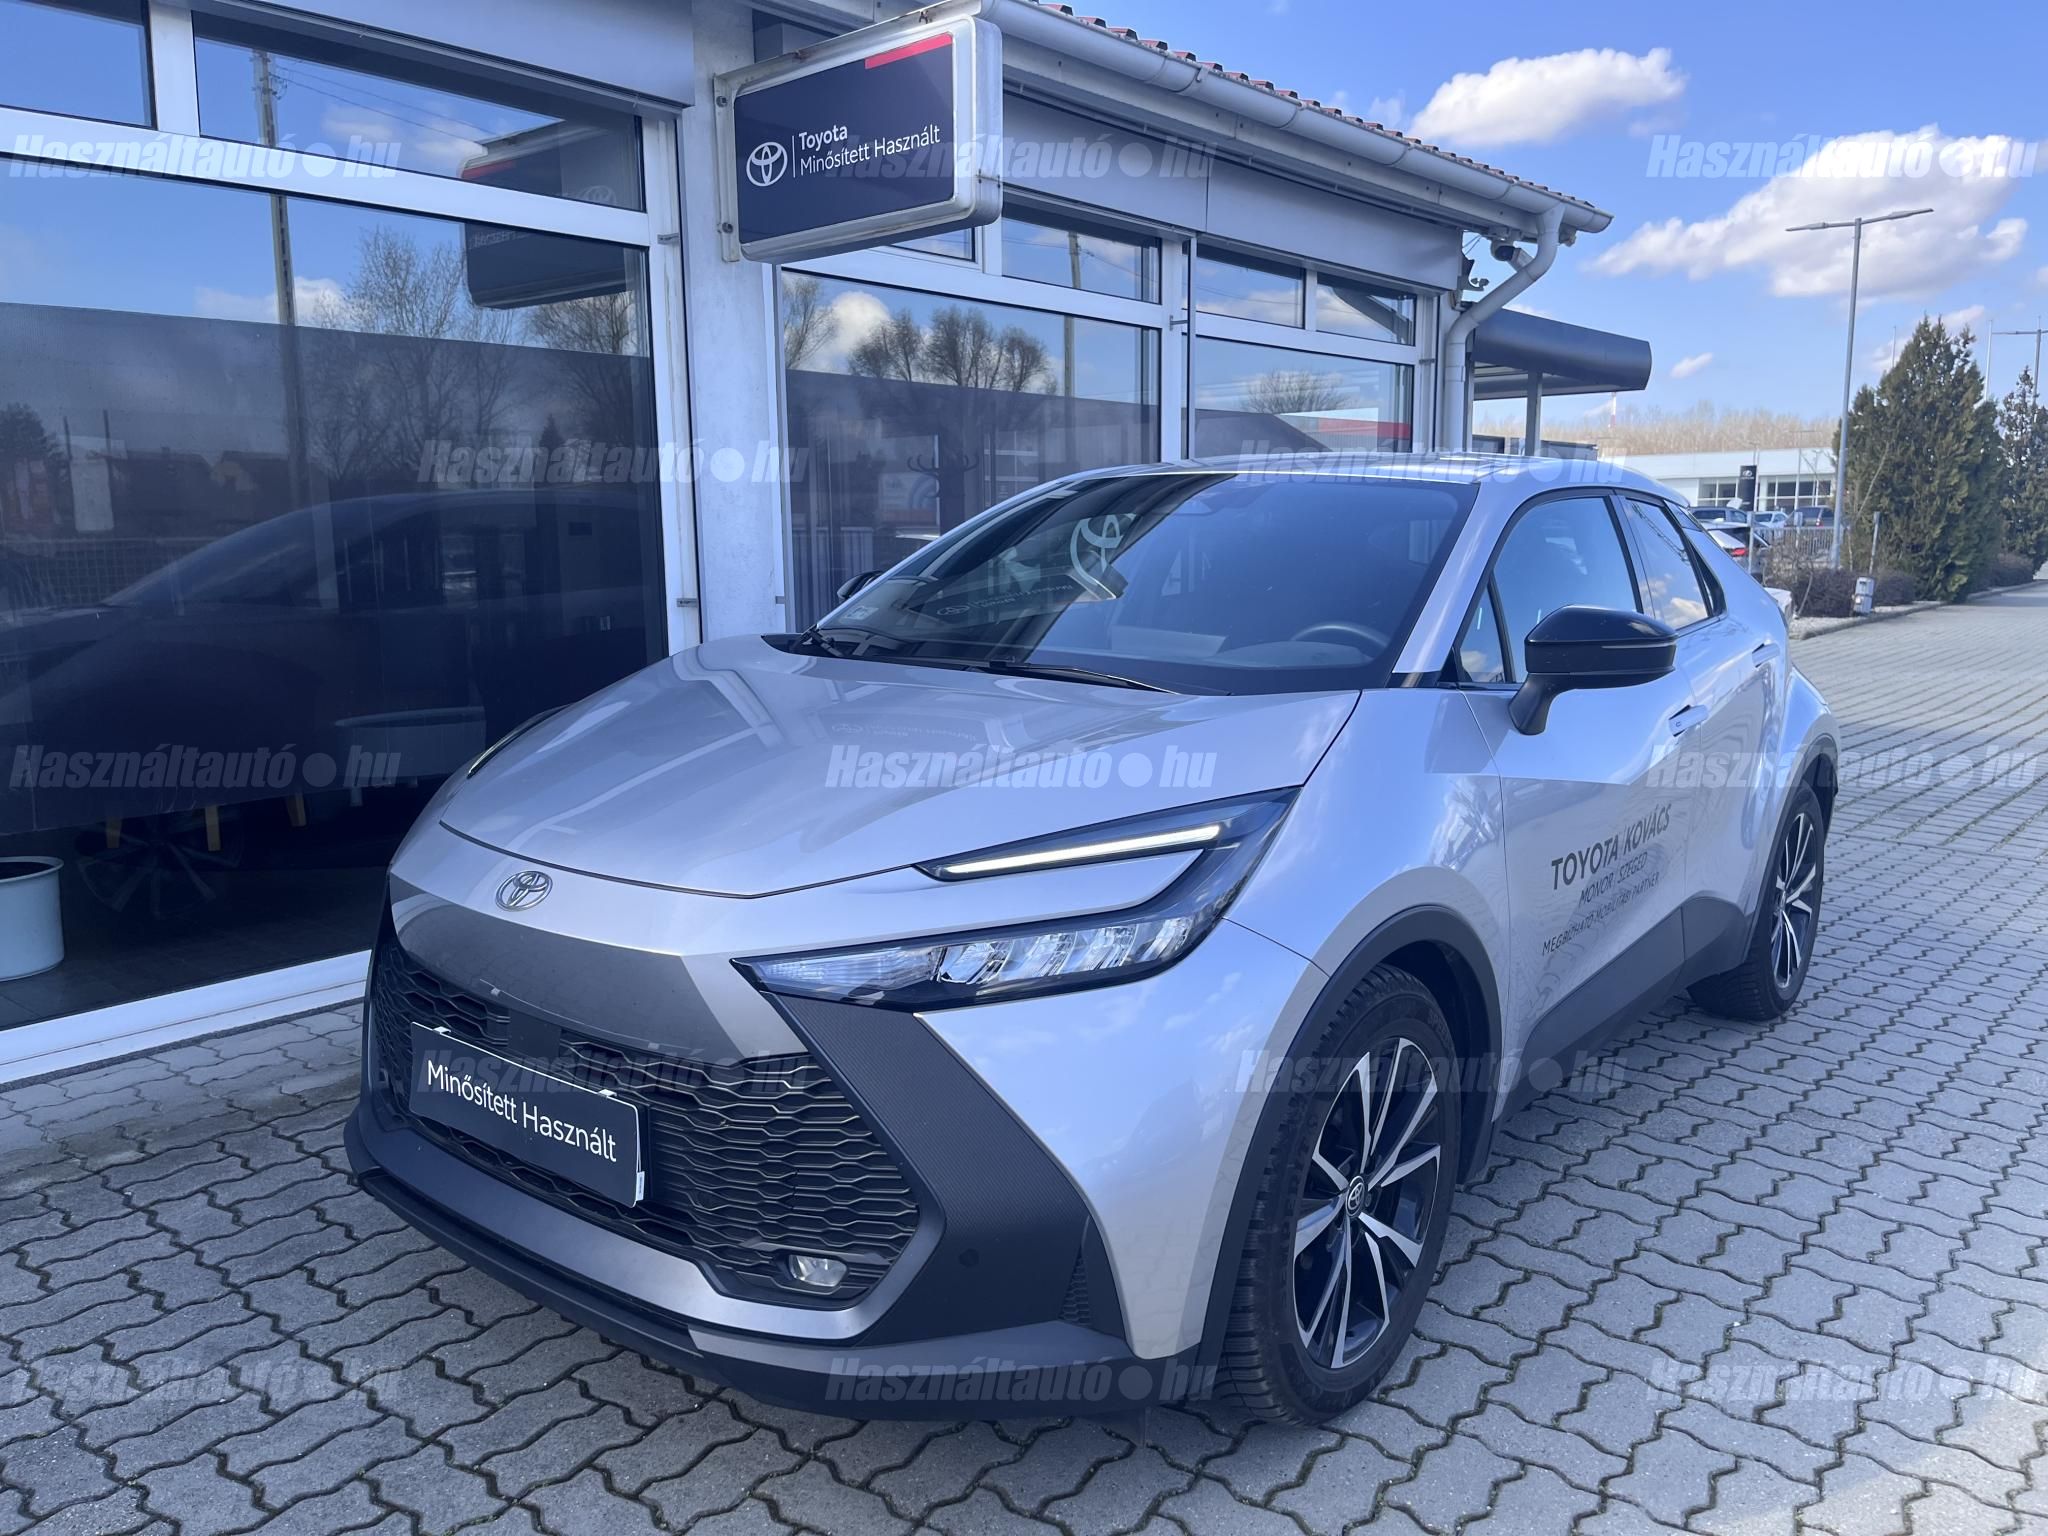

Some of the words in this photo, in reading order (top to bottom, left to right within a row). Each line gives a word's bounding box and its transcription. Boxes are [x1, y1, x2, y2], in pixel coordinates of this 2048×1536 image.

[799, 125, 848, 151] Toyota
[800, 143, 870, 176] Minősített
[874, 124, 940, 157] Használt
[1551, 834, 1619, 890] TOYOTA
[1624, 803, 1672, 855] KOVÁCS
[1579, 872, 1614, 908] MONOR
[1617, 851, 1648, 884] SZEGED
[427, 1060, 518, 1124] Minősített
[522, 1101, 618, 1162] Használt
